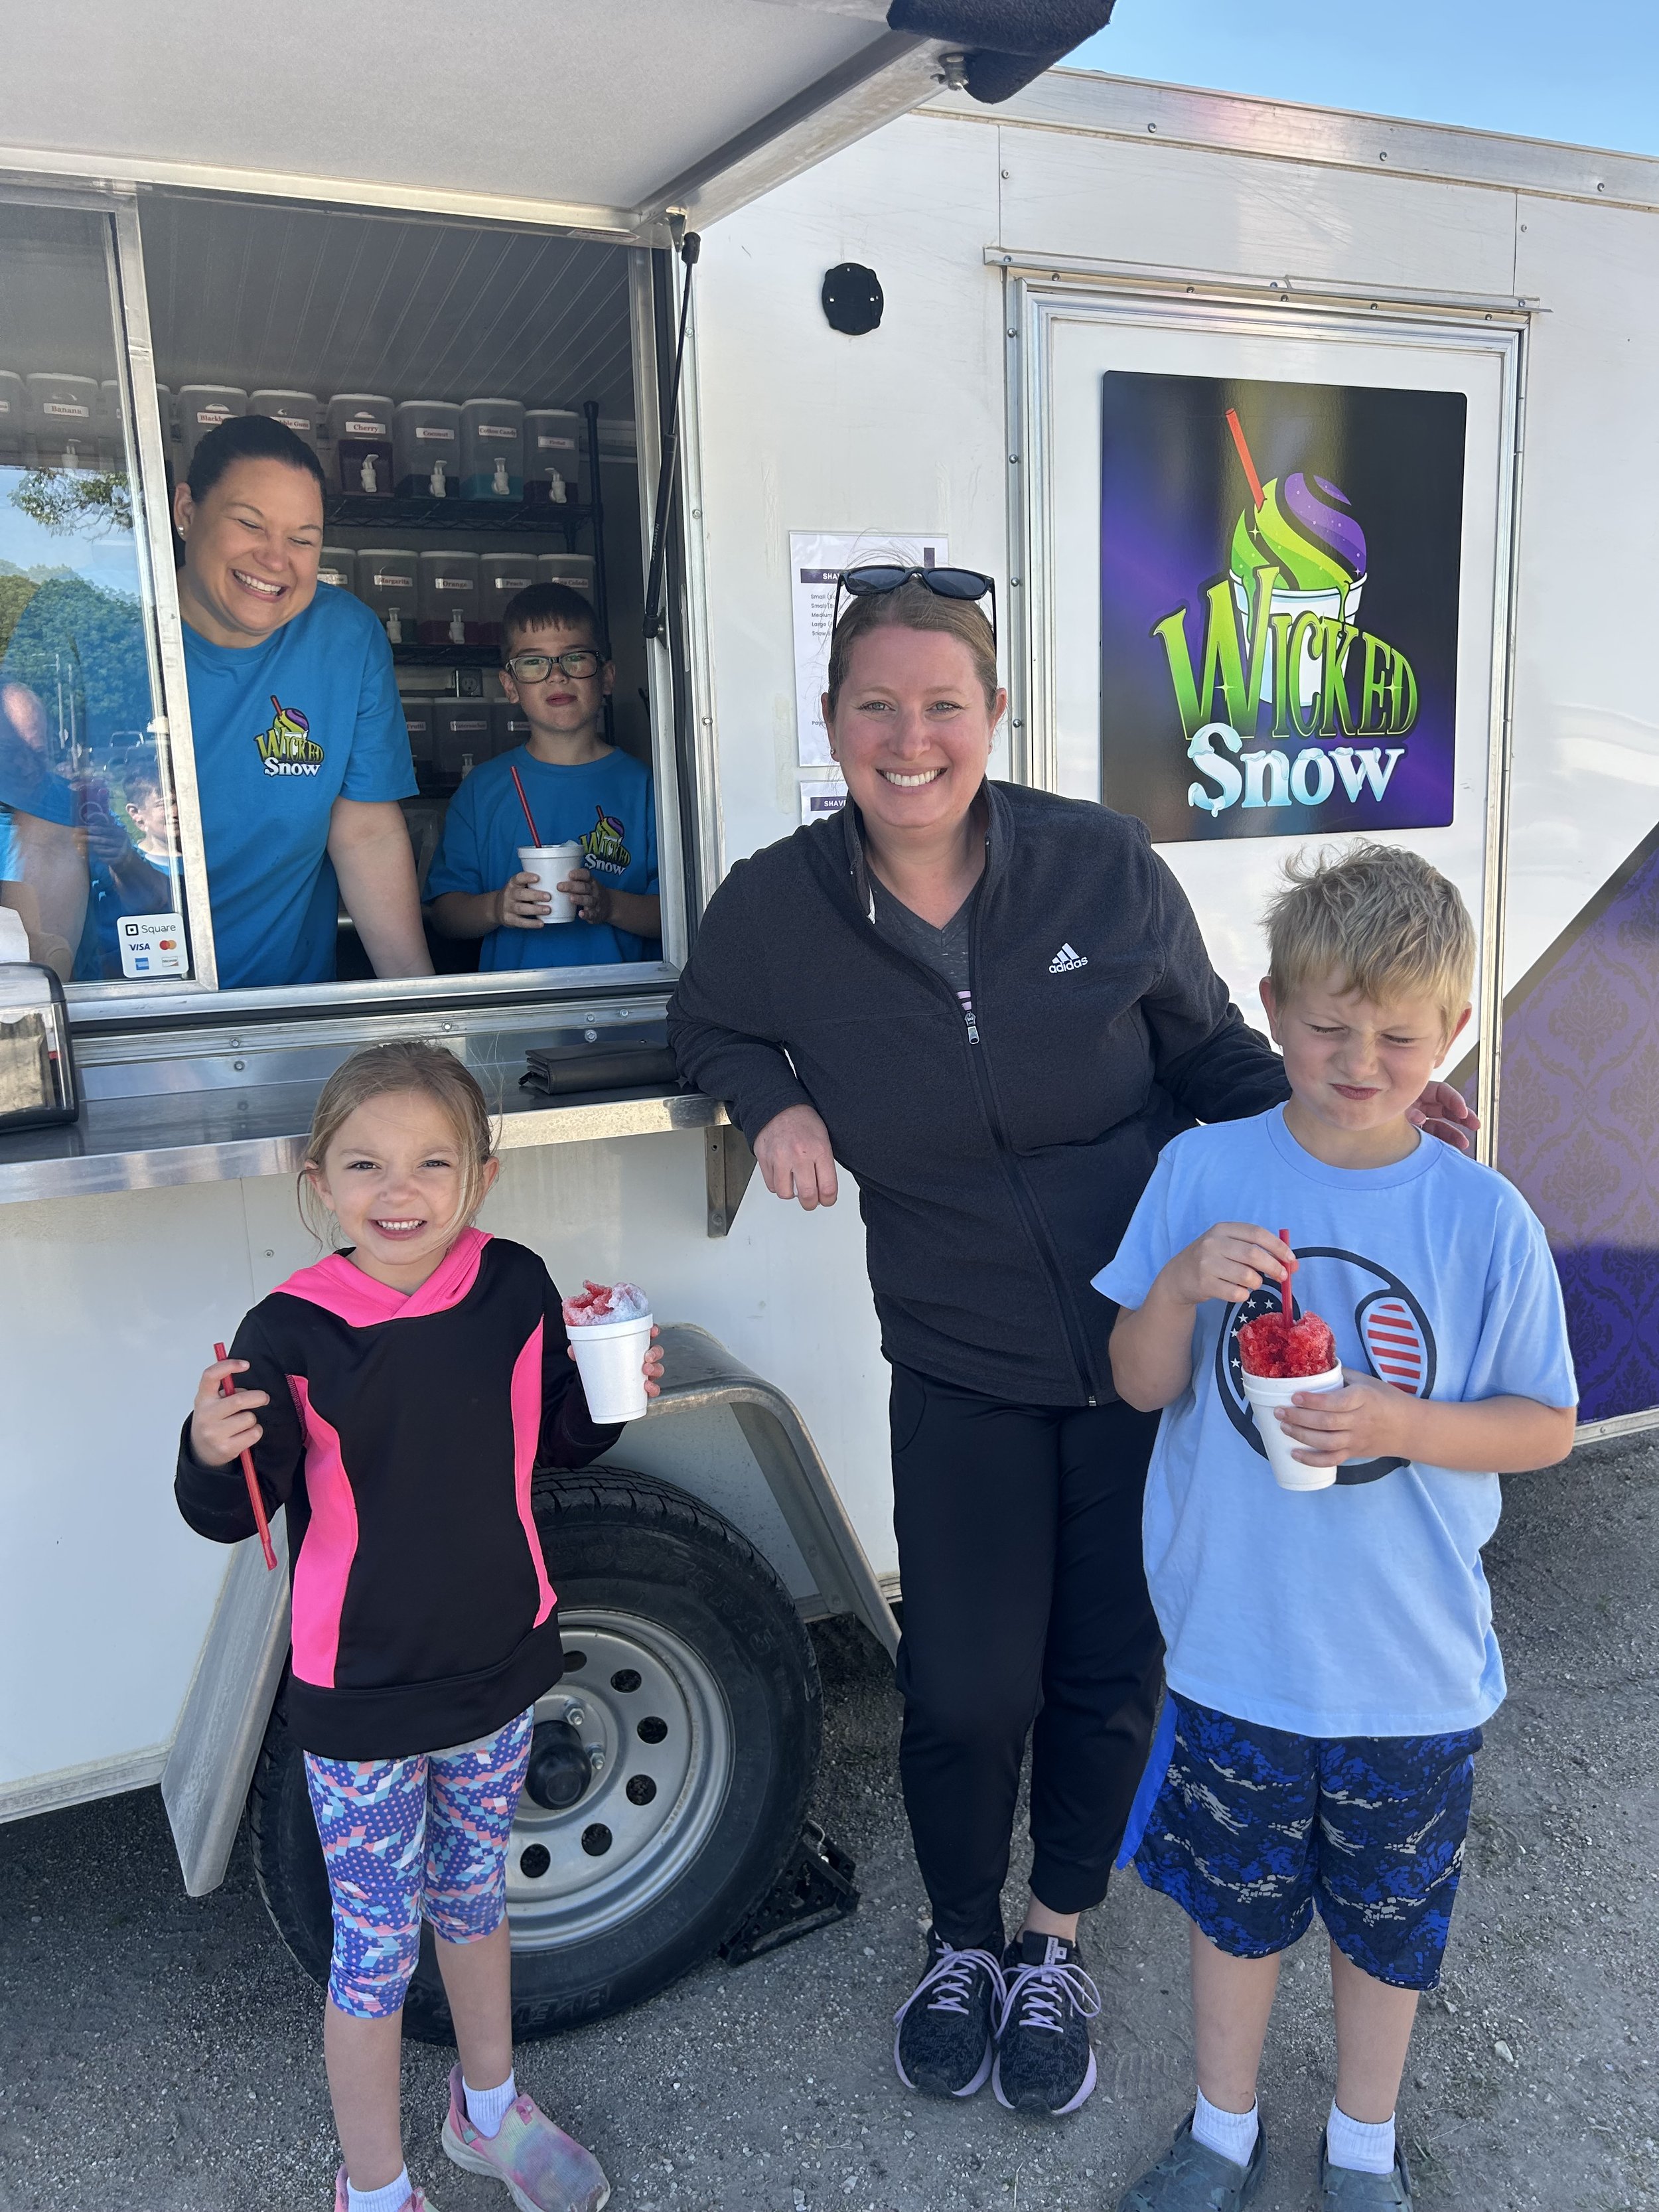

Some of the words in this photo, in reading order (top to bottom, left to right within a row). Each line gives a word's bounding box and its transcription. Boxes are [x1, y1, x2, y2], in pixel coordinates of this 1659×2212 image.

[52, 405, 82, 415] Banana
[354, 423, 378, 433] Cherry
[1153, 566, 1419, 740] WICKED
[255, 727, 323, 763] WICKED
[264, 757, 321, 776] Snow
[1188, 722, 1405, 817] Snow
[580, 831, 631, 867] WICKED
[585, 853, 626, 876] Snow
[141, 924, 177, 934] Square
[1048, 956, 1088, 974] adidas
